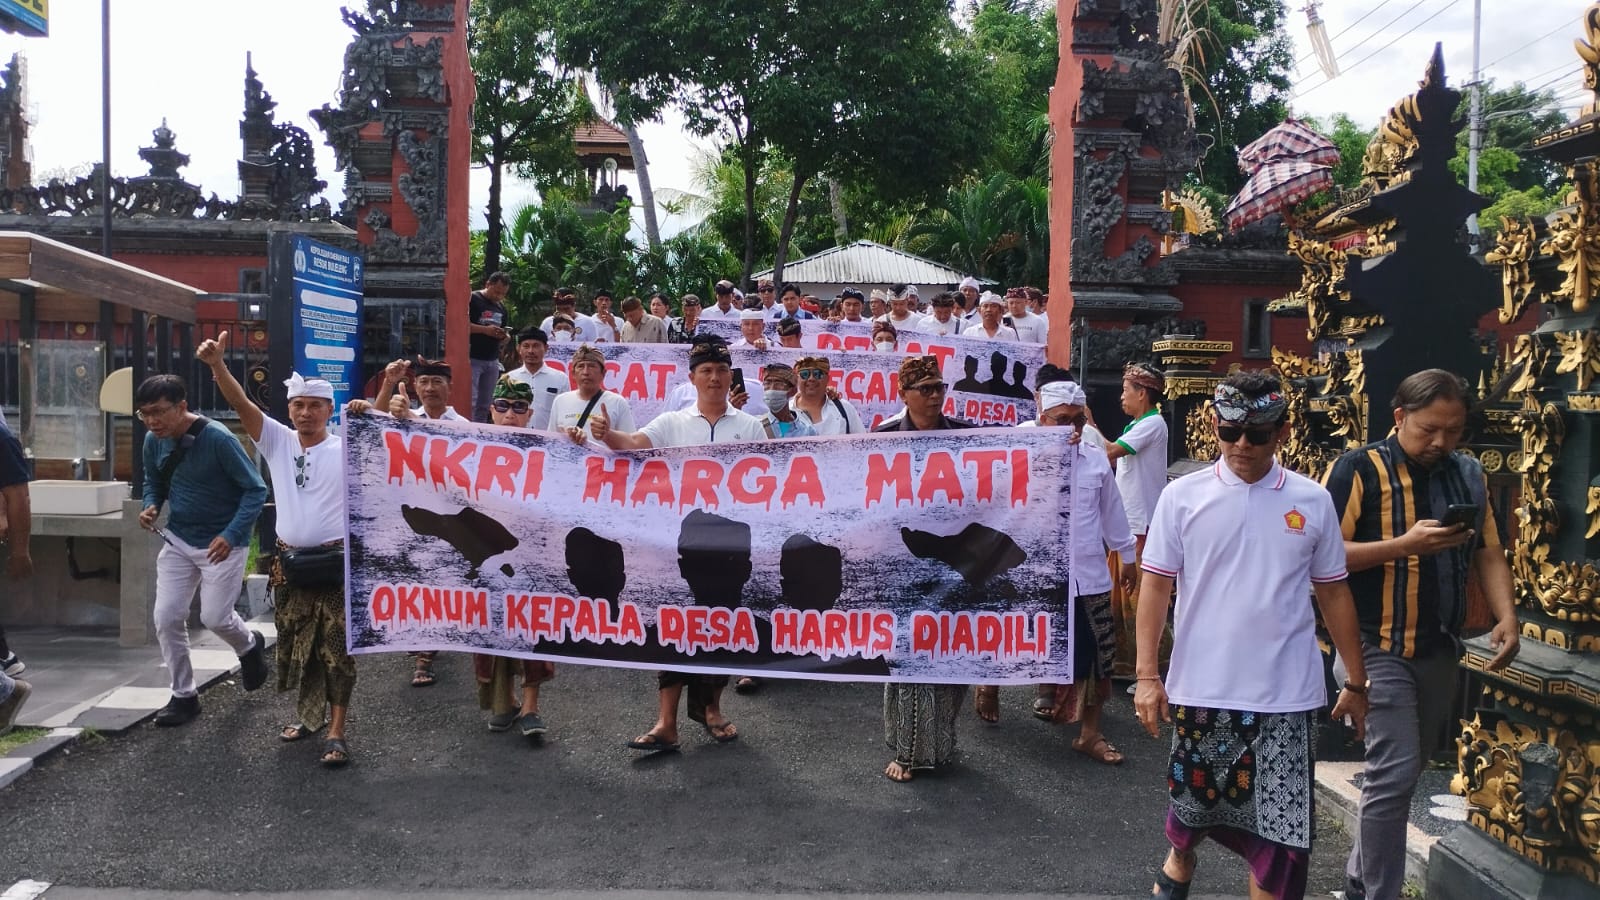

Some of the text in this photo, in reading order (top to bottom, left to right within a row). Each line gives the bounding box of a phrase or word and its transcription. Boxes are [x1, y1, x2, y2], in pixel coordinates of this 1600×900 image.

[965, 399, 1016, 425] DESA
[384, 431, 1030, 515] NKRI HARGA MATI
[371, 586, 1047, 661] OKNUM KEPALA DESA HARUS DIADILI
